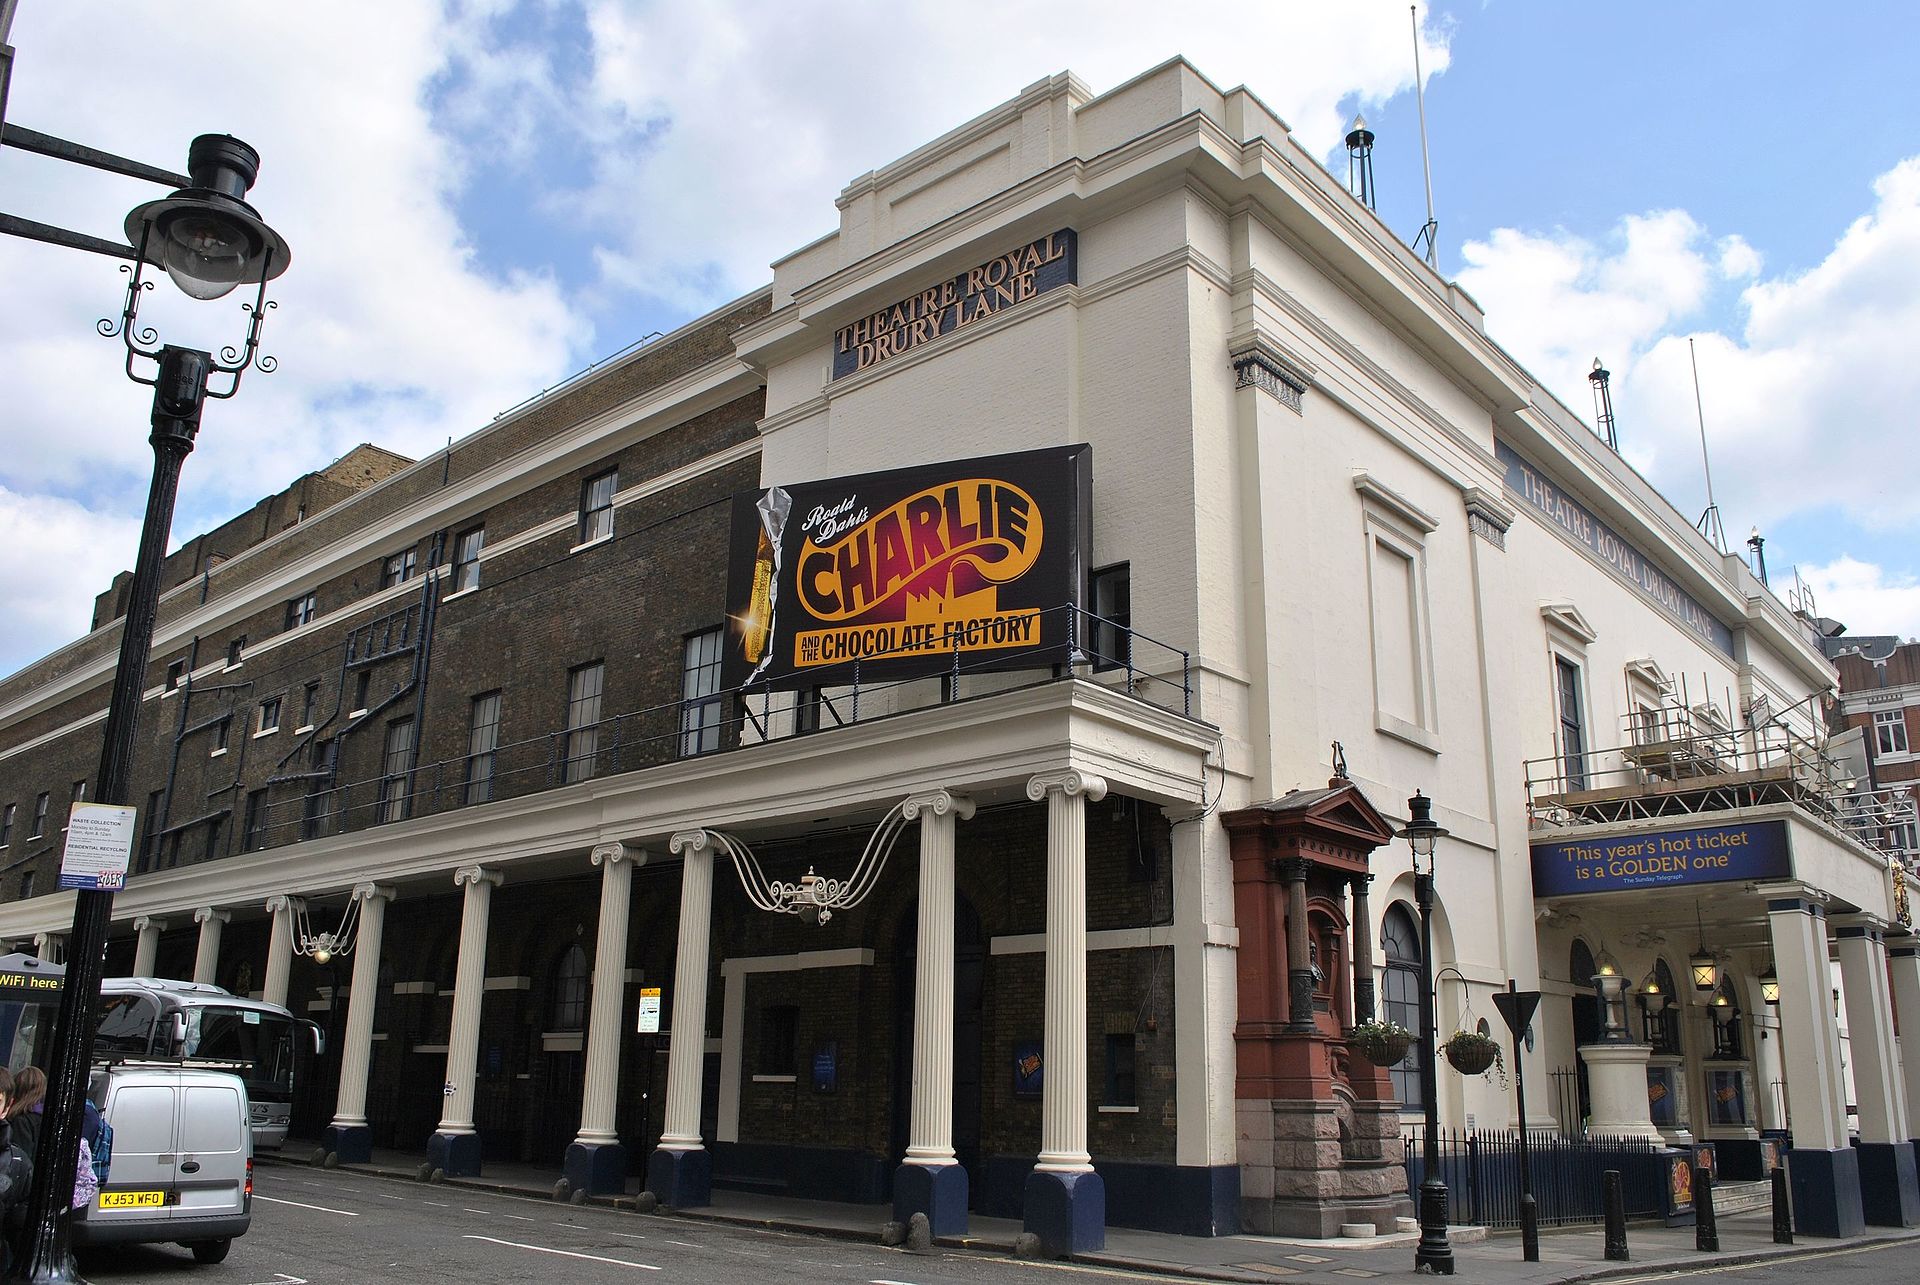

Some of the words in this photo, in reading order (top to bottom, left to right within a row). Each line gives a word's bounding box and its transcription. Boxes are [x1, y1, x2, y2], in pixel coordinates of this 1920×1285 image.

[837, 278, 957, 353] THEATRE
[967, 233, 1064, 297] ROYAL
[856, 308, 946, 371] DRURY
[954, 270, 1039, 330] LANE
[801, 494, 857, 531] Roald
[815, 506, 869, 544] Dahl's
[801, 483, 1030, 615] CHARLIE
[1519, 464, 1592, 546] THEATRE
[1595, 525, 1641, 585] ROYAL
[1643, 564, 1681, 615] DRURY
[1684, 598, 1713, 641] LANE
[801, 635, 820, 650] AND
[821, 623, 936, 660] CHOCOLATE
[943, 613, 1034, 649] FACTORY
[801, 650, 819, 662] THE
[1559, 845, 1602, 862] 'This
[1606, 840, 1655, 862] year's
[1660, 838, 1691, 853] hot
[1696, 831, 1749, 849] ticket
[1575, 865, 1590, 879] is
[1594, 866, 1605, 878] a
[1609, 855, 1687, 876] GOLDEN
[1693, 851, 1731, 869] one'
[1635, 875, 1655, 883] Sunday
[1656, 873, 1684, 882] Telegraph
[0, 974, 25, 987] WiFi
[30, 976, 58, 989] here
[105, 1194, 134, 1205] KJ53
